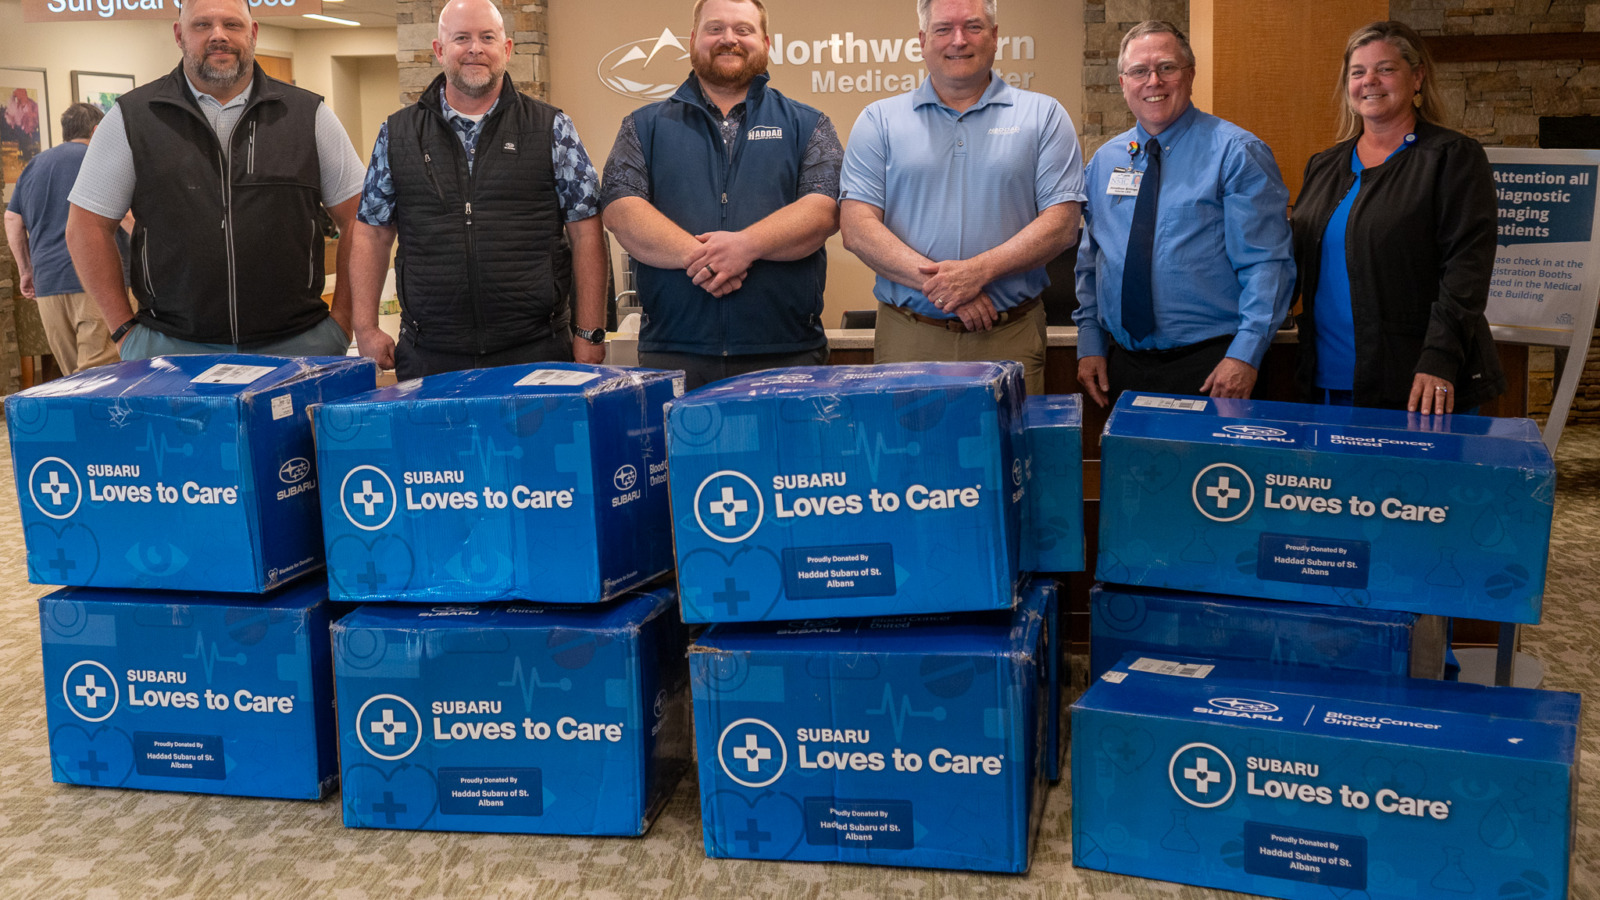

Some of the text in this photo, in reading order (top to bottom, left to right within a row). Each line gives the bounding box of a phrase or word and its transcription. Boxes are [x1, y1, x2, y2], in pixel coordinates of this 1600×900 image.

[767, 33, 1035, 65] Northwern
[811, 69, 924, 93] Medical
[748, 129, 782, 140] HADDAD
[1493, 171, 1589, 185] Attention all
[1497, 206, 1550, 223] maging
[1497, 224, 1550, 237] atients
[1495, 257, 1584, 269] ase check in at the
[1491, 267, 1572, 279] gistration Booths
[1490, 279, 1582, 292] ated in the Medical
[1505, 290, 1544, 302] Building
[1212, 432, 1295, 443] SUBARU
[1330, 434, 1434, 447] Blood Cancer
[1330, 440, 1383, 448] United
[86, 464, 140, 478] SUBARU
[649, 460, 665, 475] Blood
[403, 470, 465, 485] SUBARU
[649, 472, 667, 487] United
[772, 471, 847, 490] SUBARU
[1265, 473, 1332, 490] SUBARU
[89, 479, 152, 502] Loves
[156, 481, 179, 503] to
[276, 480, 316, 501] SUBARU
[405, 487, 479, 510] Loves
[483, 486, 508, 509] to
[611, 489, 641, 508] SUBARU
[774, 492, 864, 518] Loves
[868, 488, 900, 513] to
[1264, 488, 1343, 514] Loves
[1349, 496, 1376, 517] to
[1285, 544, 1309, 552] Proudly
[1274, 556, 1305, 565] Haddad
[1306, 559, 1335, 567] Subaru
[1346, 561, 1358, 569] St.
[798, 568, 882, 579] Haddad Subaru of St.
[1301, 567, 1329, 576] Albans
[826, 580, 855, 588] Albans
[127, 669, 187, 684] SUBARU
[128, 684, 200, 709] Loves
[204, 689, 229, 710] to
[431, 701, 502, 714] SUBARU
[1193, 707, 1283, 722] SUBARU
[1323, 717, 1382, 730] United
[1325, 711, 1442, 730] Blood Cancer
[433, 717, 516, 740] Loves
[522, 718, 551, 740] to
[797, 728, 870, 744] SUBARU
[799, 745, 885, 770] Loves
[892, 748, 922, 772] to
[1246, 756, 1319, 777] SUBARU
[519, 789, 529, 797] St.
[1247, 772, 1333, 804] Loves
[1339, 785, 1370, 809] to
[829, 808, 851, 817] Pudly
[1271, 834, 1339, 851] Proudly Donated By
[1259, 846, 1352, 867] Haddad Subaru of St.
[1290, 861, 1321, 873] Albans
